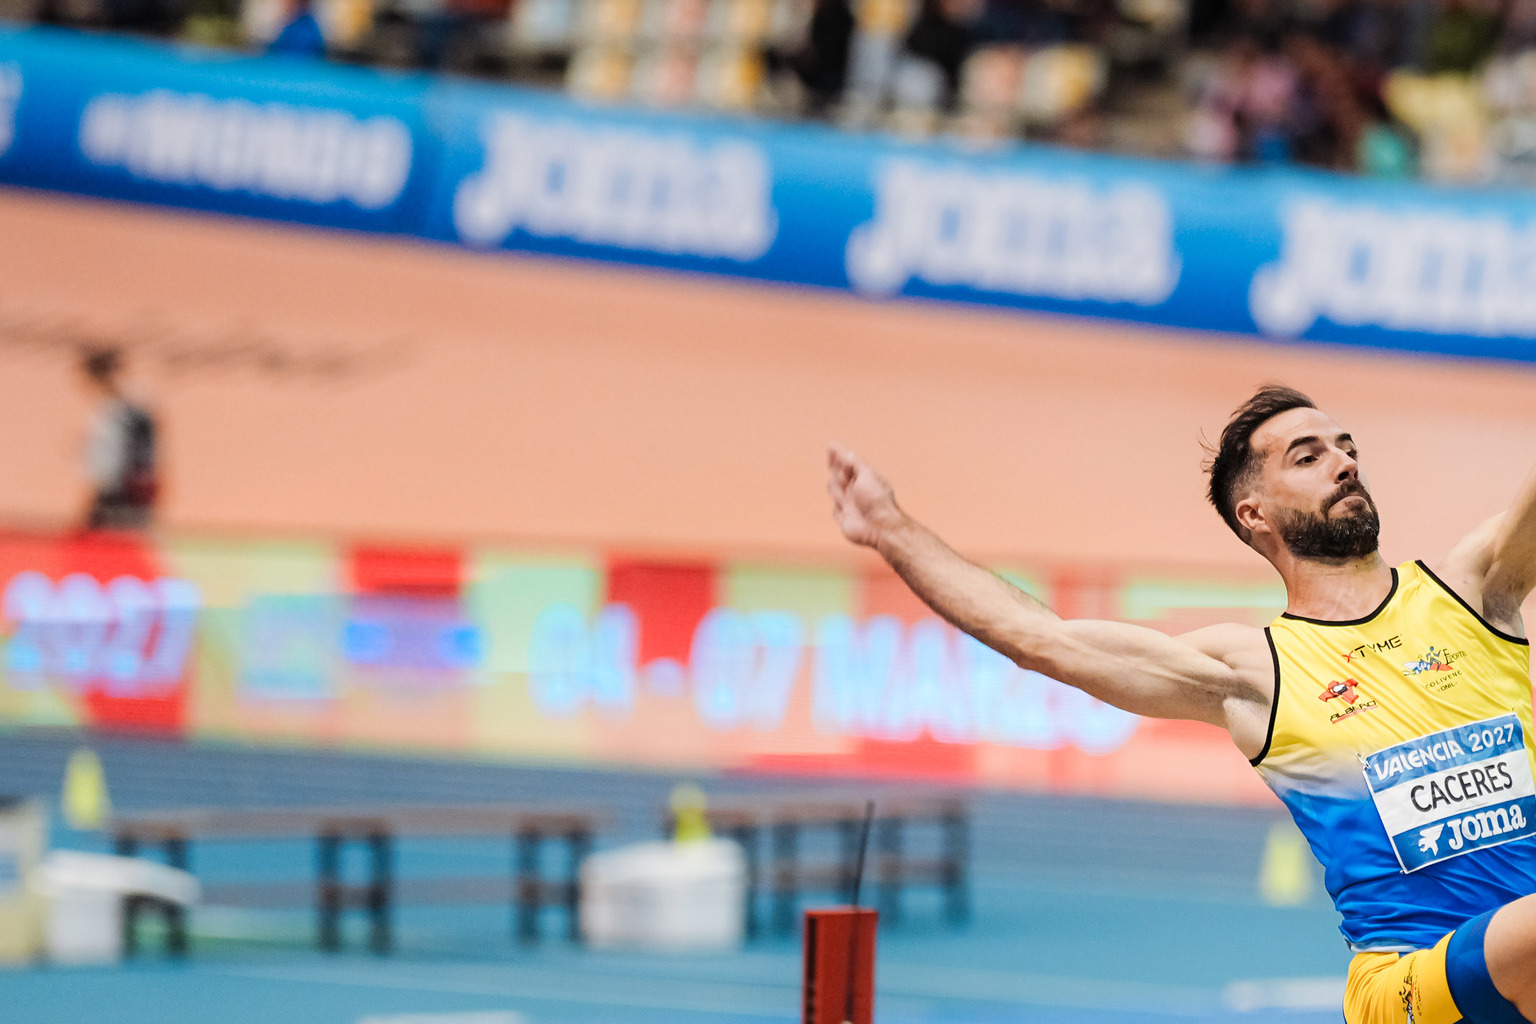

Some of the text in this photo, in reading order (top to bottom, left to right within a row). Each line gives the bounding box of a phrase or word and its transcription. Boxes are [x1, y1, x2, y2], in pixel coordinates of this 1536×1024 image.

[1374, 723, 1515, 781] VALENCIA 2027
[1410, 761, 1513, 812] CACERES
